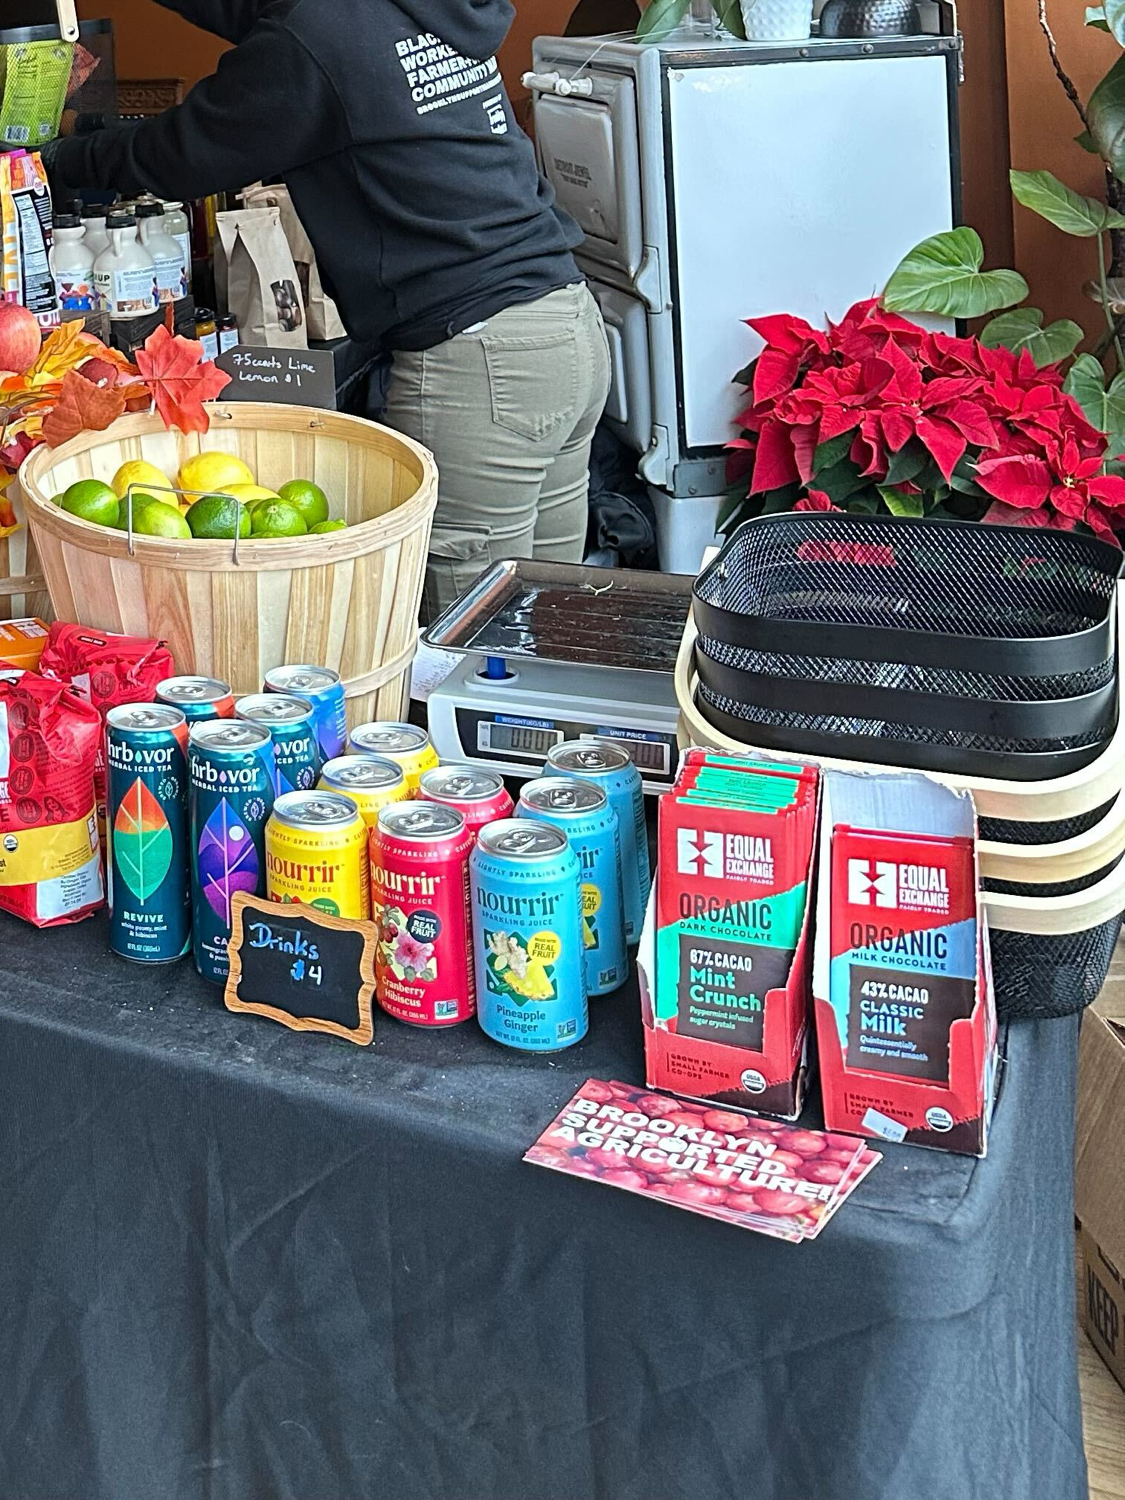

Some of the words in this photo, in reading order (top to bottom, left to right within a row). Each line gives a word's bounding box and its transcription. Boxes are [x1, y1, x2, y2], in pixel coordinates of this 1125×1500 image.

[400, 44, 458, 72] WORKE
[289, 357, 316, 373] Lime
[239, 371, 279, 384] Lemon
[610, 729, 625, 738] UNIT
[627, 731, 647, 740] PRICE
[294, 754, 309, 763] TEA
[133, 765, 155, 773] ICED
[157, 764, 173, 772] TEA
[219, 784, 240, 793] ICED
[242, 784, 258, 793] TEA
[392, 849, 439, 858] SPARKLING
[725, 833, 774, 863] EQUAL
[267, 850, 340, 883] nourrir
[508, 868, 557, 878] SPARKLING
[725, 858, 775, 880] EXCHANGE
[307, 883, 333, 893] JUICE
[371, 861, 441, 896] nourrir
[898, 863, 949, 894] EQUAL
[407, 896, 433, 905] JUICE
[477, 886, 560, 916] nourrir
[898, 890, 950, 909] EXCHANGE
[123, 911, 164, 923] REVIVE
[481, 909, 526, 926] SPARKLING
[527, 918, 553, 927] JUICE
[679, 891, 773, 930] ORGANIC
[410, 926, 437, 939] FRUIT
[413, 920, 436, 932] REAL
[679, 921, 708, 933] DARK
[709, 926, 773, 942] CHOCOLATE
[249, 922, 320, 960] Drinks
[534, 943, 556, 952] REAL
[849, 921, 948, 959] ORGANIC
[531, 950, 556, 959] FRUIT
[714, 952, 753, 972] CACAO
[851, 951, 878, 962] MILK
[881, 954, 946, 971] CHOCOLATE
[290, 961, 322, 985] $4
[690, 965, 736, 989] Mint
[381, 975, 426, 998] Cranberry
[860, 980, 888, 998] 43%
[888, 984, 929, 1005] CACAO
[384, 988, 422, 1007] Hibiscus
[689, 984, 762, 1012] Crunch
[496, 1004, 546, 1023] Pineapple
[689, 1005, 728, 1019] Peppermint
[728, 1011, 754, 1023] infused
[859, 1000, 924, 1019] CLASSIC
[504, 1019, 539, 1034] Ginger
[708, 1019, 736, 1030] crystals
[861, 1013, 907, 1036] Milk
[859, 1034, 917, 1051] Quintessentially
[886, 1048, 900, 1057] and
[901, 1051, 928, 1061] smooth
[572, 1098, 777, 1158] BROOKLYN
[561, 1112, 789, 1177] SUPPORTED
